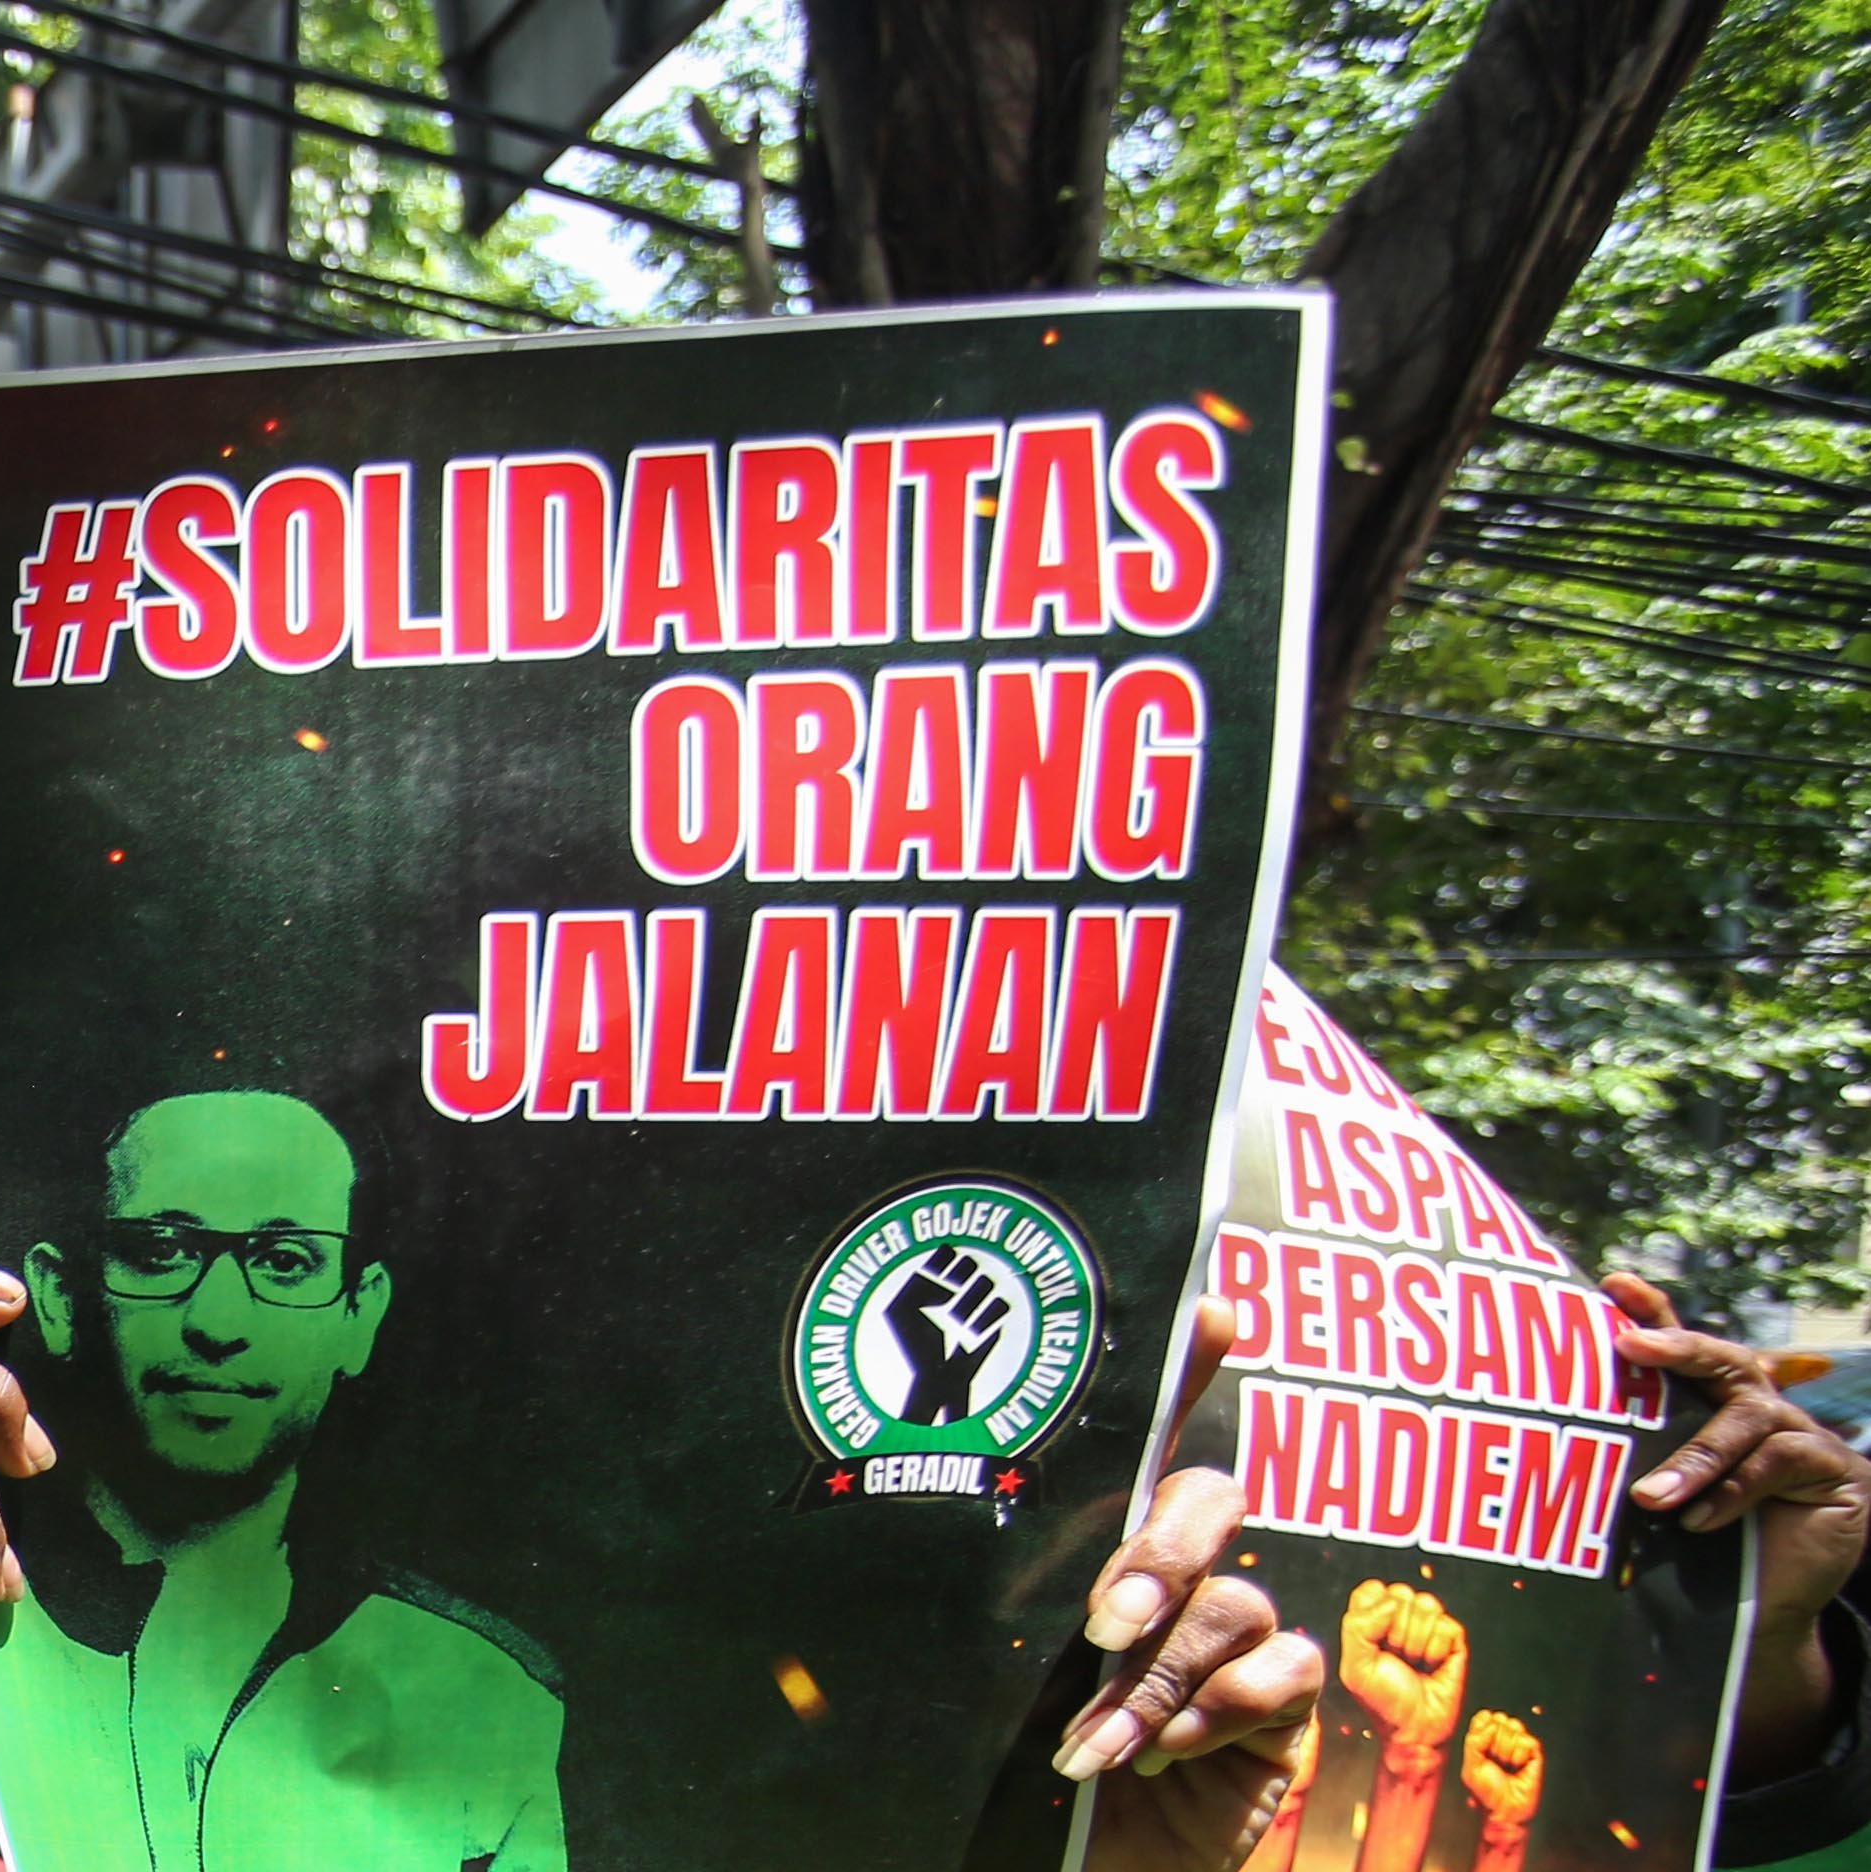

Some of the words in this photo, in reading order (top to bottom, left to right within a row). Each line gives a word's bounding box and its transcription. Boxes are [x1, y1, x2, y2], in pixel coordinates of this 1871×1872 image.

[13, 408, 1227, 687] #SOLIDARITAS
[631, 657, 1208, 886] ORANG
[420, 905, 1182, 1123] JALANAN
[819, 1219, 908, 1320] DRIVER
[911, 1199, 1011, 1244] GOJEK
[1005, 1218, 1078, 1308] UNTUK
[810, 1325, 883, 1451] GERAKAN
[984, 1308, 1082, 1447] KEADILAN
[863, 1456, 985, 1495] GERADIL
[1236, 1376, 1633, 1579] NADIEM!
